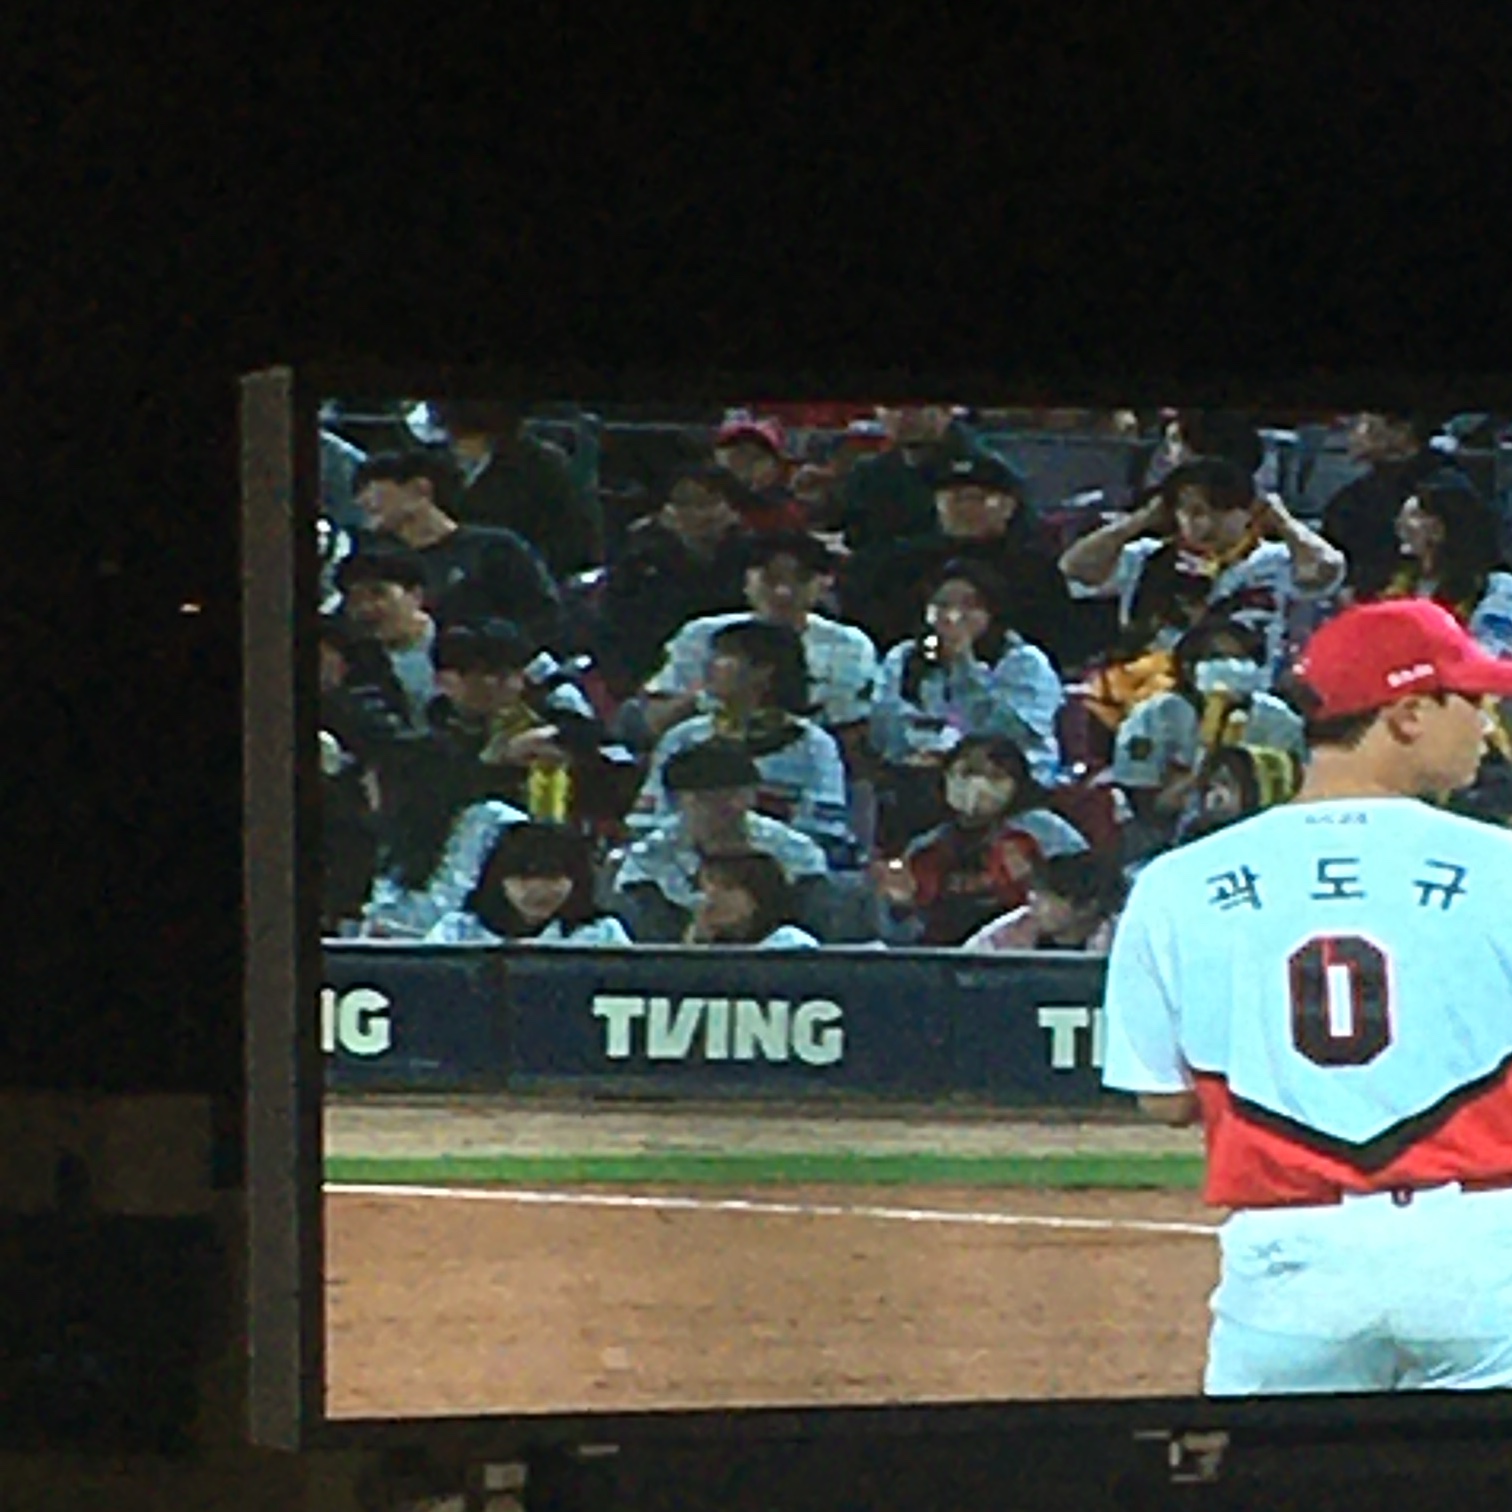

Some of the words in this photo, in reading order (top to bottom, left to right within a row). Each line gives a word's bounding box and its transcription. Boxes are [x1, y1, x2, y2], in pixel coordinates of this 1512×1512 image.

[593, 994, 844, 1066] TVING
[1286, 931, 1393, 1068] 0
[1038, 1006, 1104, 1069] T
